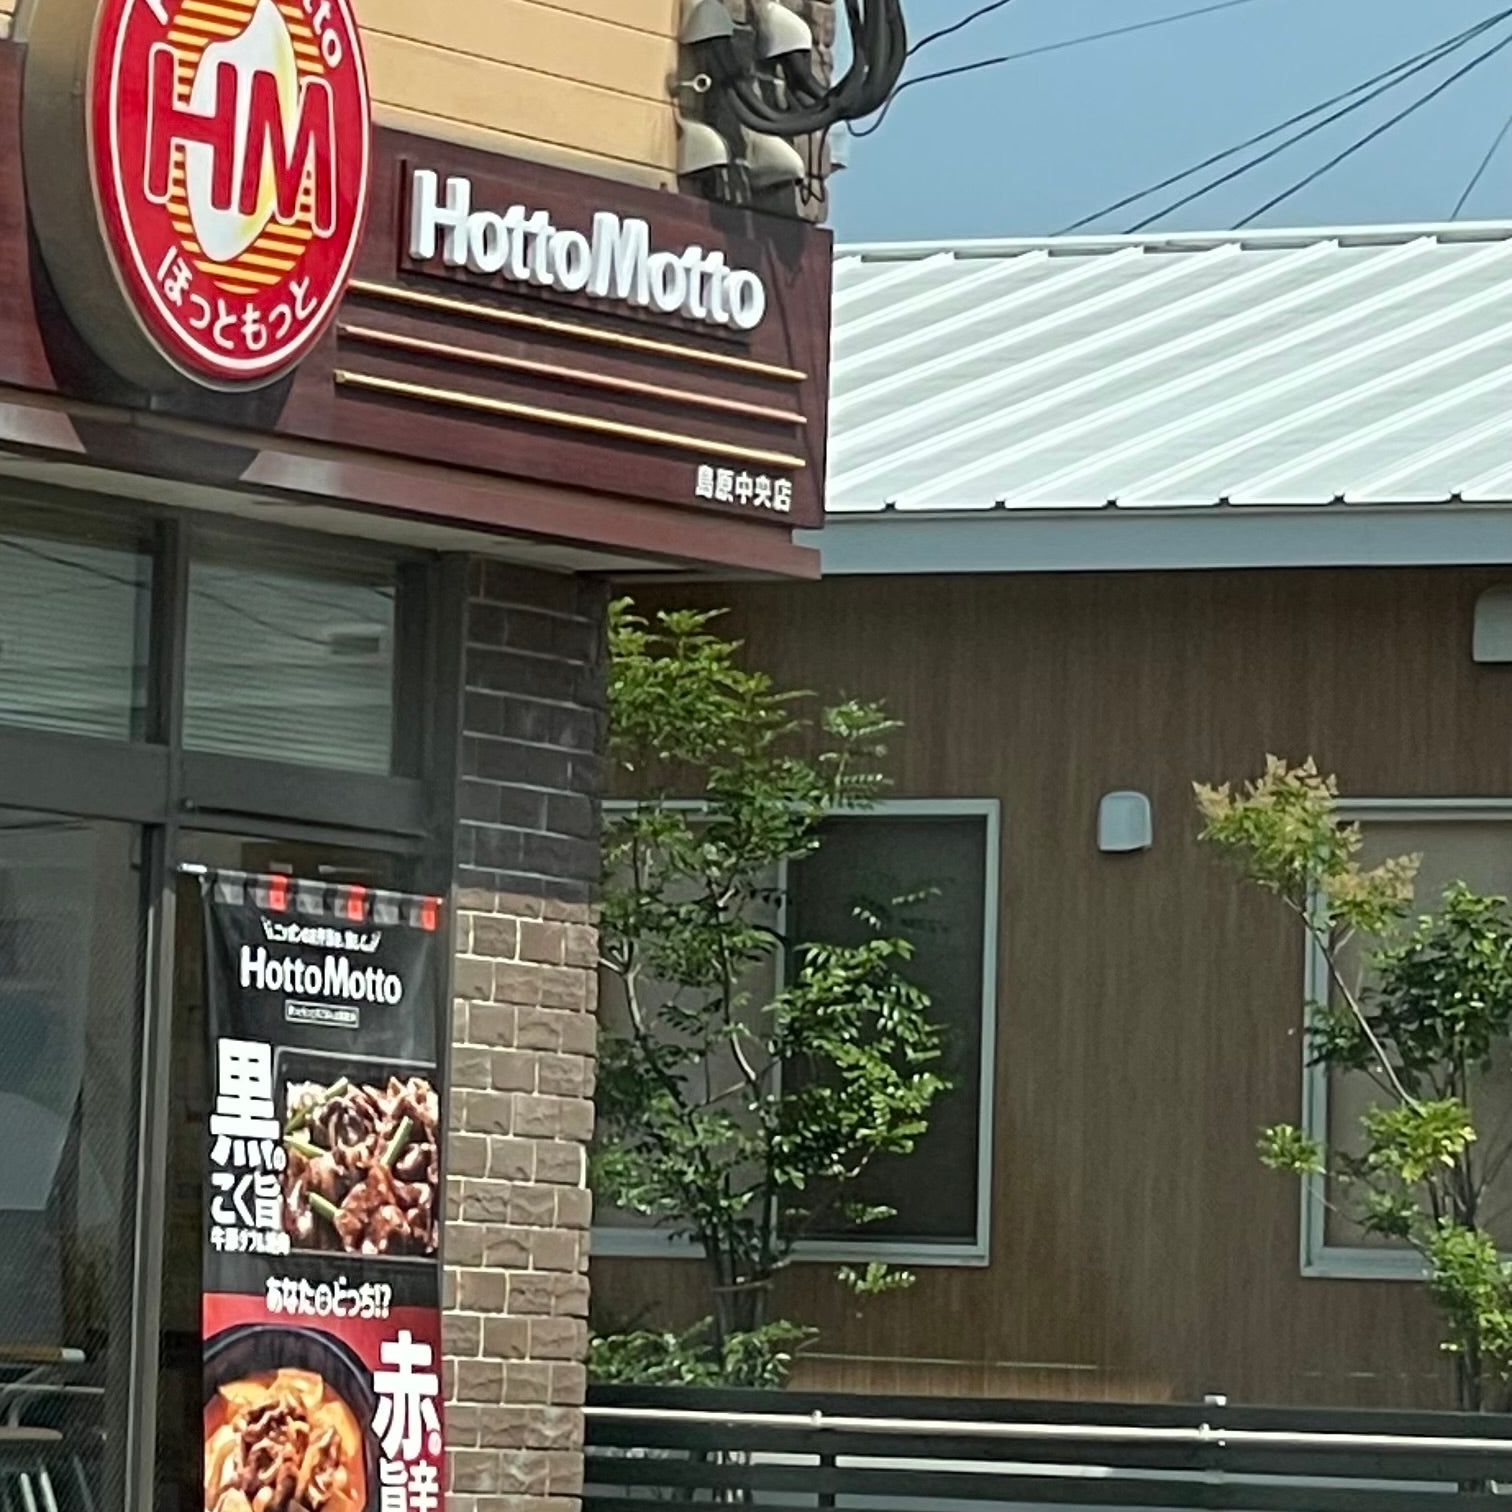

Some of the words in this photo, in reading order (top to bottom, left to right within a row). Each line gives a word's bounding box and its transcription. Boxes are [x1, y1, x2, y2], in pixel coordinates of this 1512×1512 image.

[156, 245, 319, 351] ほっともっと
[409, 169, 767, 331] HottoMotto
[239, 944, 403, 1005] HottoMotto
